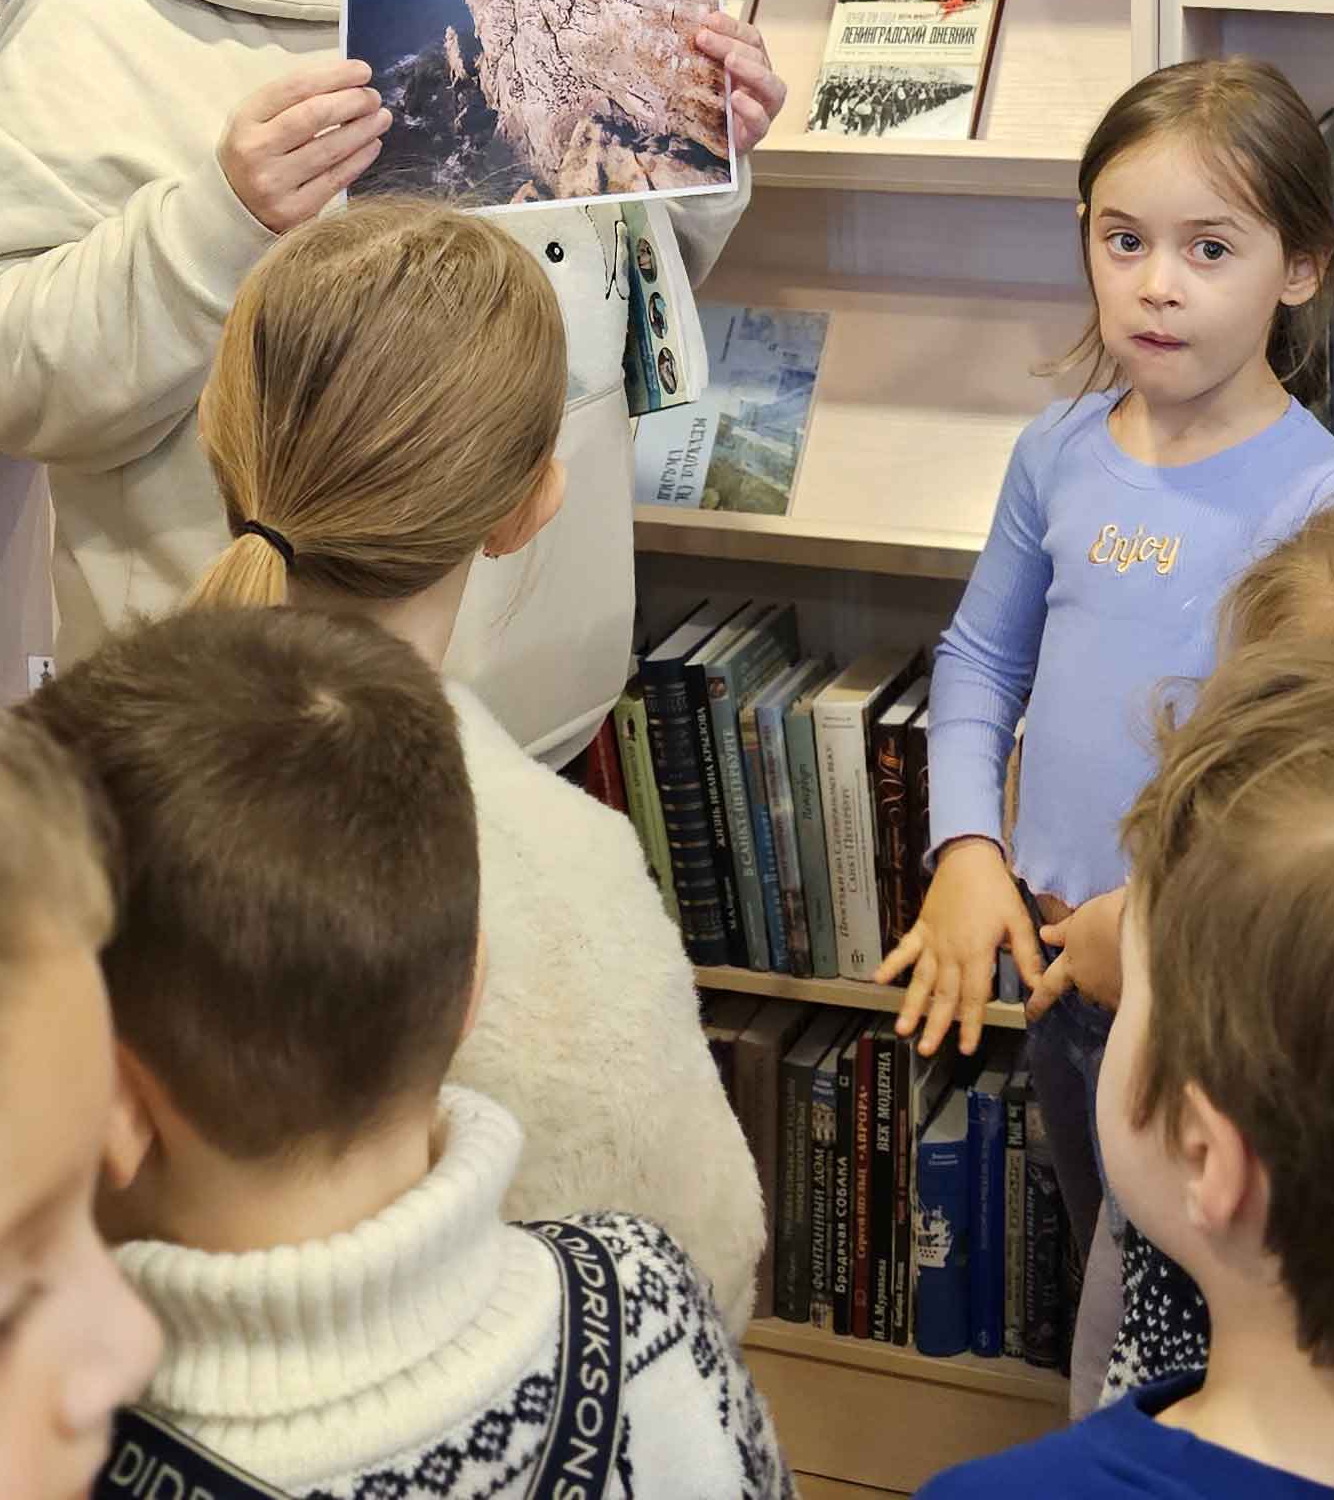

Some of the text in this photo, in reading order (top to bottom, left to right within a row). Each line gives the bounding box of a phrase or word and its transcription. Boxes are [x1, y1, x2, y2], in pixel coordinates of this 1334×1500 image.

[839, 23, 978, 46] ЛЕНИНГРАДСКИЙ ДНЕВНИК
[1088, 523, 1182, 575] Enjoy
[722, 728, 753, 866] САНКТ-ПЕТЕРБУРГЕ
[876, 1051, 893, 1152] ВЕК МОДЕРНА
[812, 1148, 827, 1290] ФОНТАННЫЙ ДОМ
[833, 1156, 849, 1294] Бродячая СОБАКА
